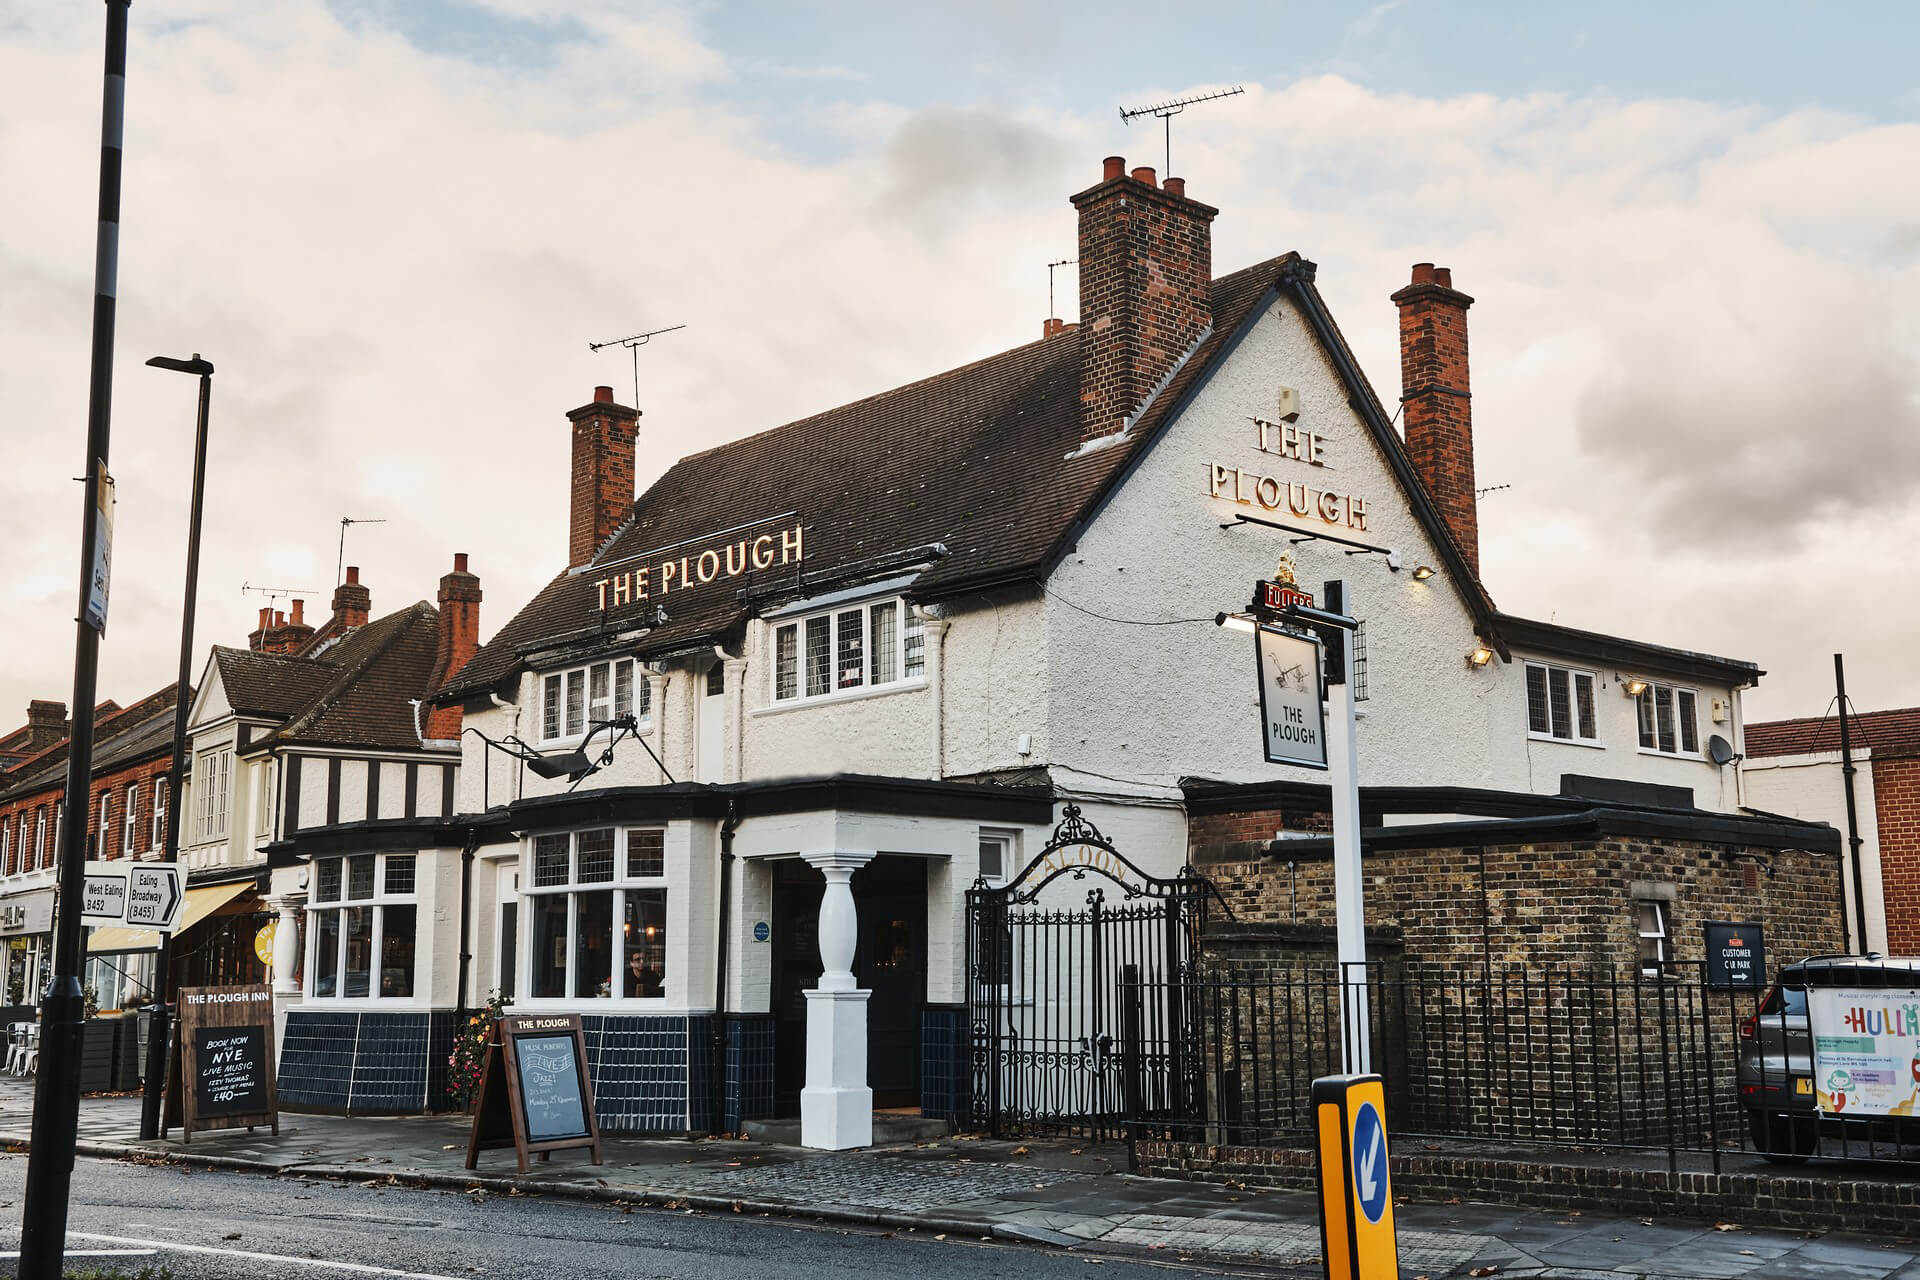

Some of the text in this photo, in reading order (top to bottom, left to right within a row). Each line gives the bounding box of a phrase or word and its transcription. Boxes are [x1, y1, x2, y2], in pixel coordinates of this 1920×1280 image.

[1254, 416, 1324, 468] THE
[1210, 462, 1368, 531] PLOUGH
[595, 524, 803, 611] THE PLOUGH
[1282, 705, 1303, 724] THE
[1273, 722, 1316, 745] PLOUGH
[139, 873, 159, 888] Ealing
[88, 884, 124, 898] West Ealing
[131, 889, 163, 904] Broadway
[86, 899, 105, 911] B452
[129, 905, 156, 921] (B455)
[1721, 948, 1752, 958] CUSTOMER
[1737, 960, 1751, 969] PARK
[186, 991, 270, 1005] THE PLOUGH INN
[517, 1018, 570, 1029] THE PLOUGH
[205, 1035, 249, 1050] BOOK NOW
[211, 1049, 244, 1065] NYE
[537, 1055, 559, 1071] LIVE
[202, 1066, 223, 1077] LIVE
[223, 1061, 254, 1073] MUSIC
[225, 1074, 250, 1084] THOMAS
[212, 1090, 235, 1102] £40
